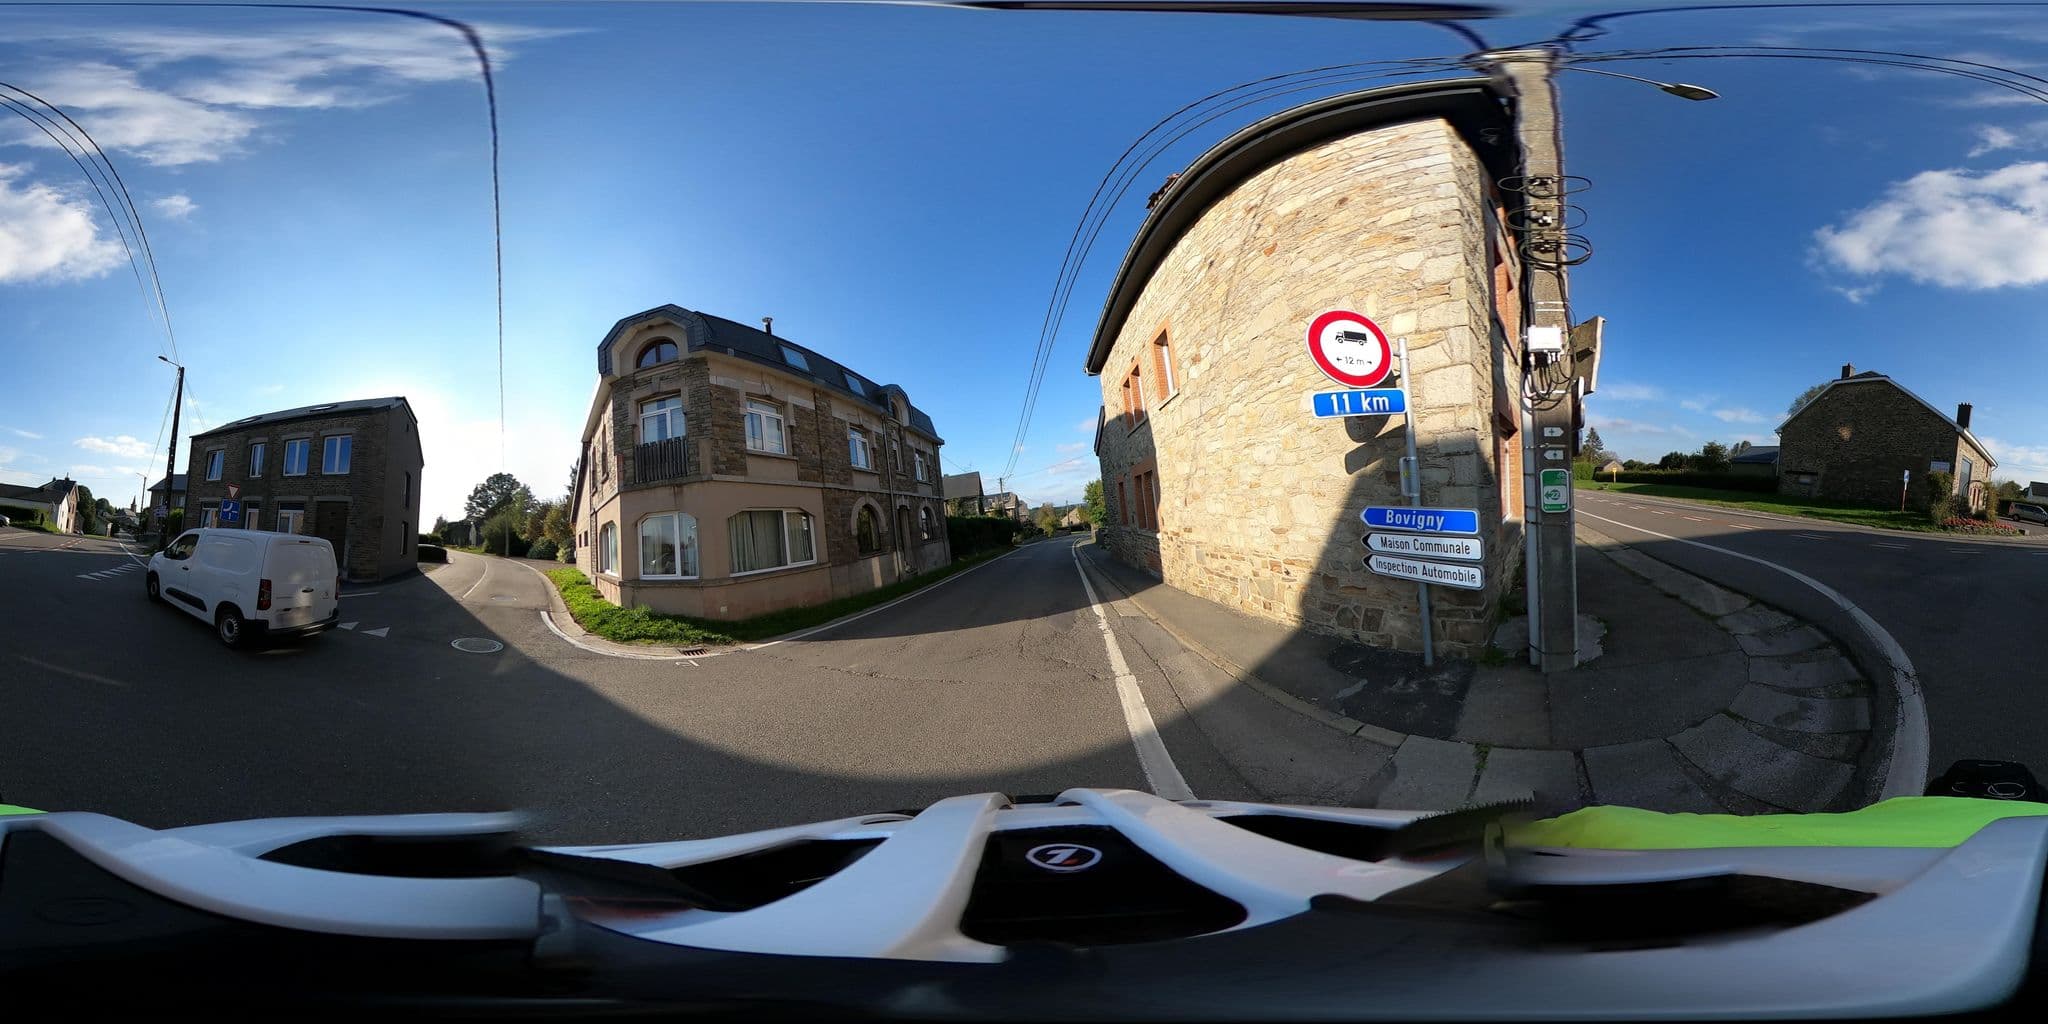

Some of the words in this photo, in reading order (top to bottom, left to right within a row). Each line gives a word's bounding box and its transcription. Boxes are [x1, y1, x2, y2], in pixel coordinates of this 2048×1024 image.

[1344, 356, 1355, 365] 12
[1361, 392, 1389, 412] km
[1386, 510, 1445, 531] Bovigny
[1380, 536, 1410, 550] Maison
[1413, 539, 1471, 555] Communale
[1375, 557, 1418, 575] Inspection
[1422, 565, 1477, 584] Automobile
